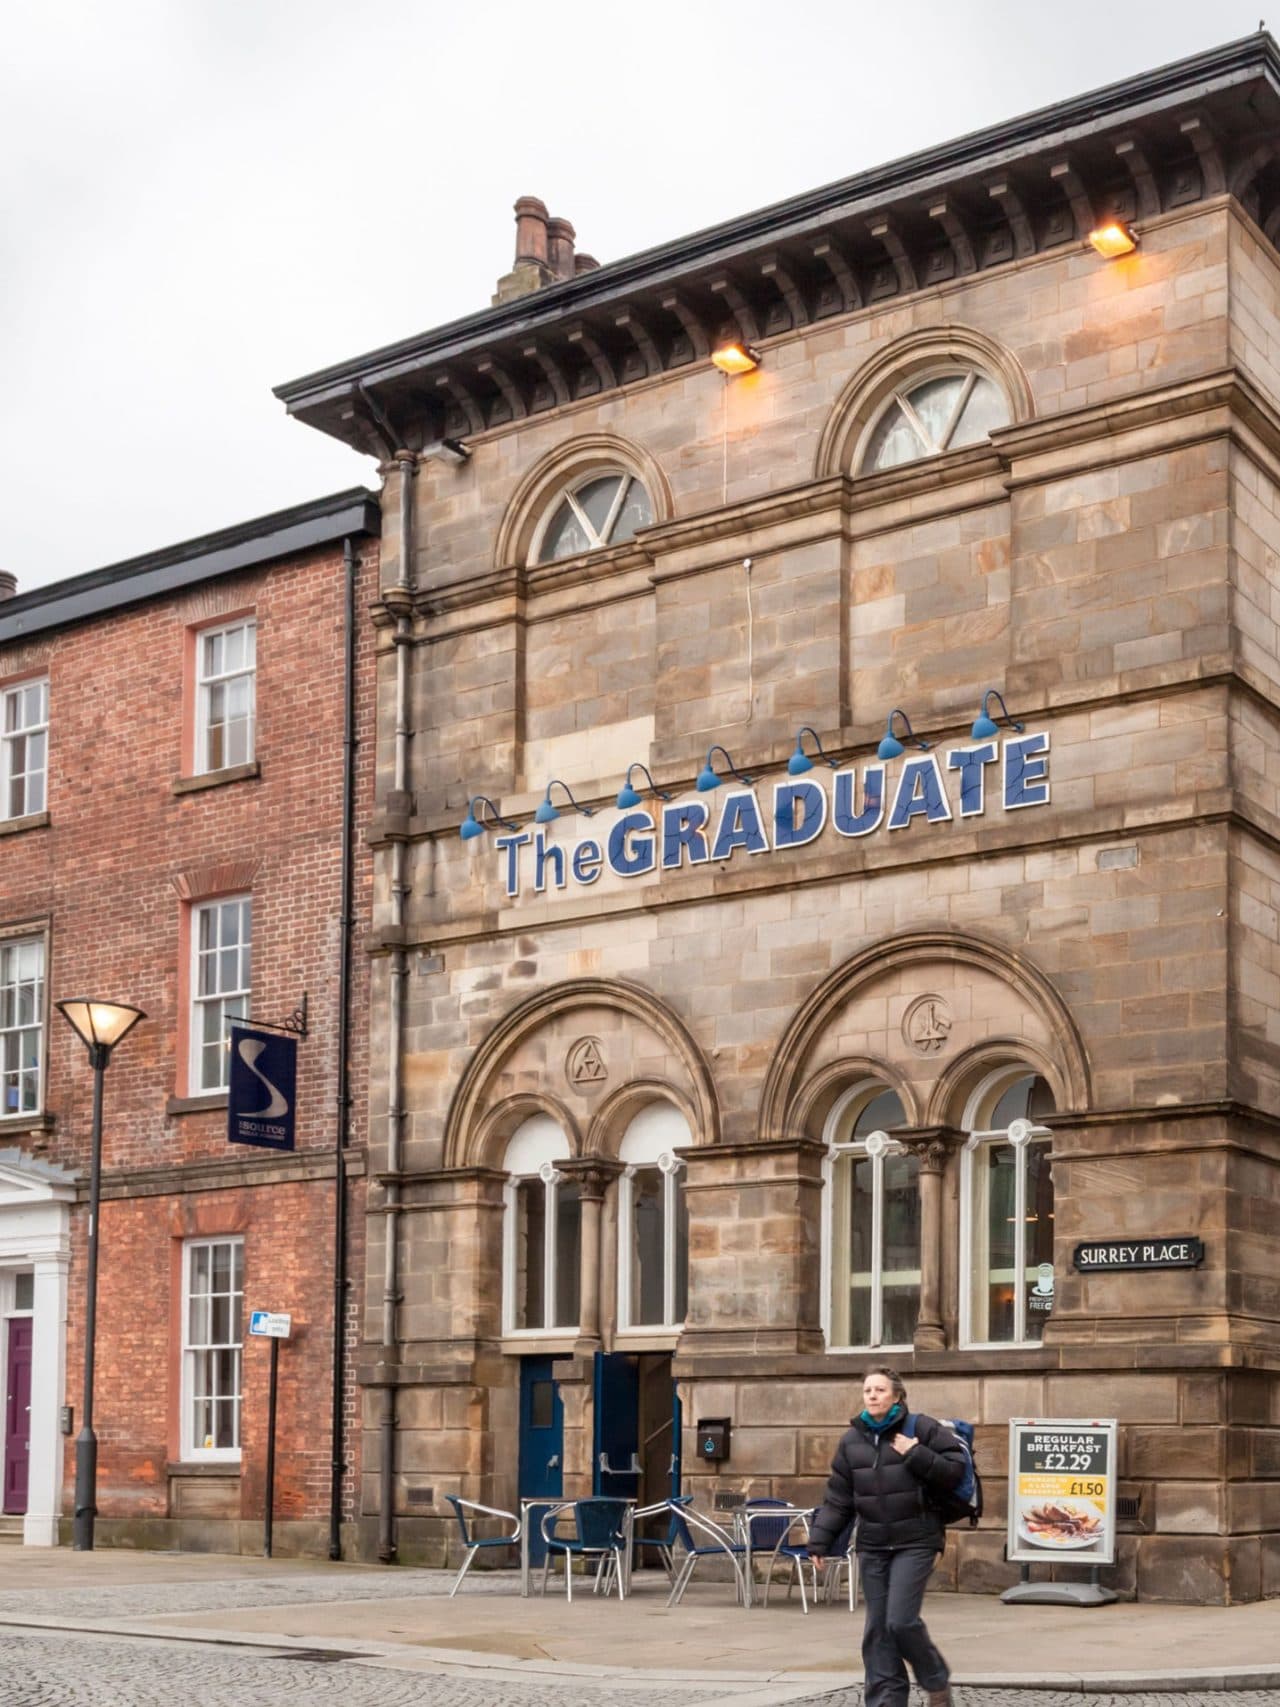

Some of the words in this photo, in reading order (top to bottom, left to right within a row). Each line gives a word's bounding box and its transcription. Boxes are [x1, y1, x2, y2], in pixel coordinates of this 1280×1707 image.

[494, 823, 602, 897] The
[606, 730, 1052, 879] GRADUATE
[1080, 1247, 1139, 1264] SURREY
[1142, 1244, 1189, 1261] PLACE
[1029, 1302, 1045, 1310] FREE
[1034, 1434, 1095, 1445] REGULAR
[1027, 1443, 1102, 1453] BREAKFAST
[1044, 1453, 1092, 1471] £2.29
[1070, 1482, 1104, 1496] £1.50
